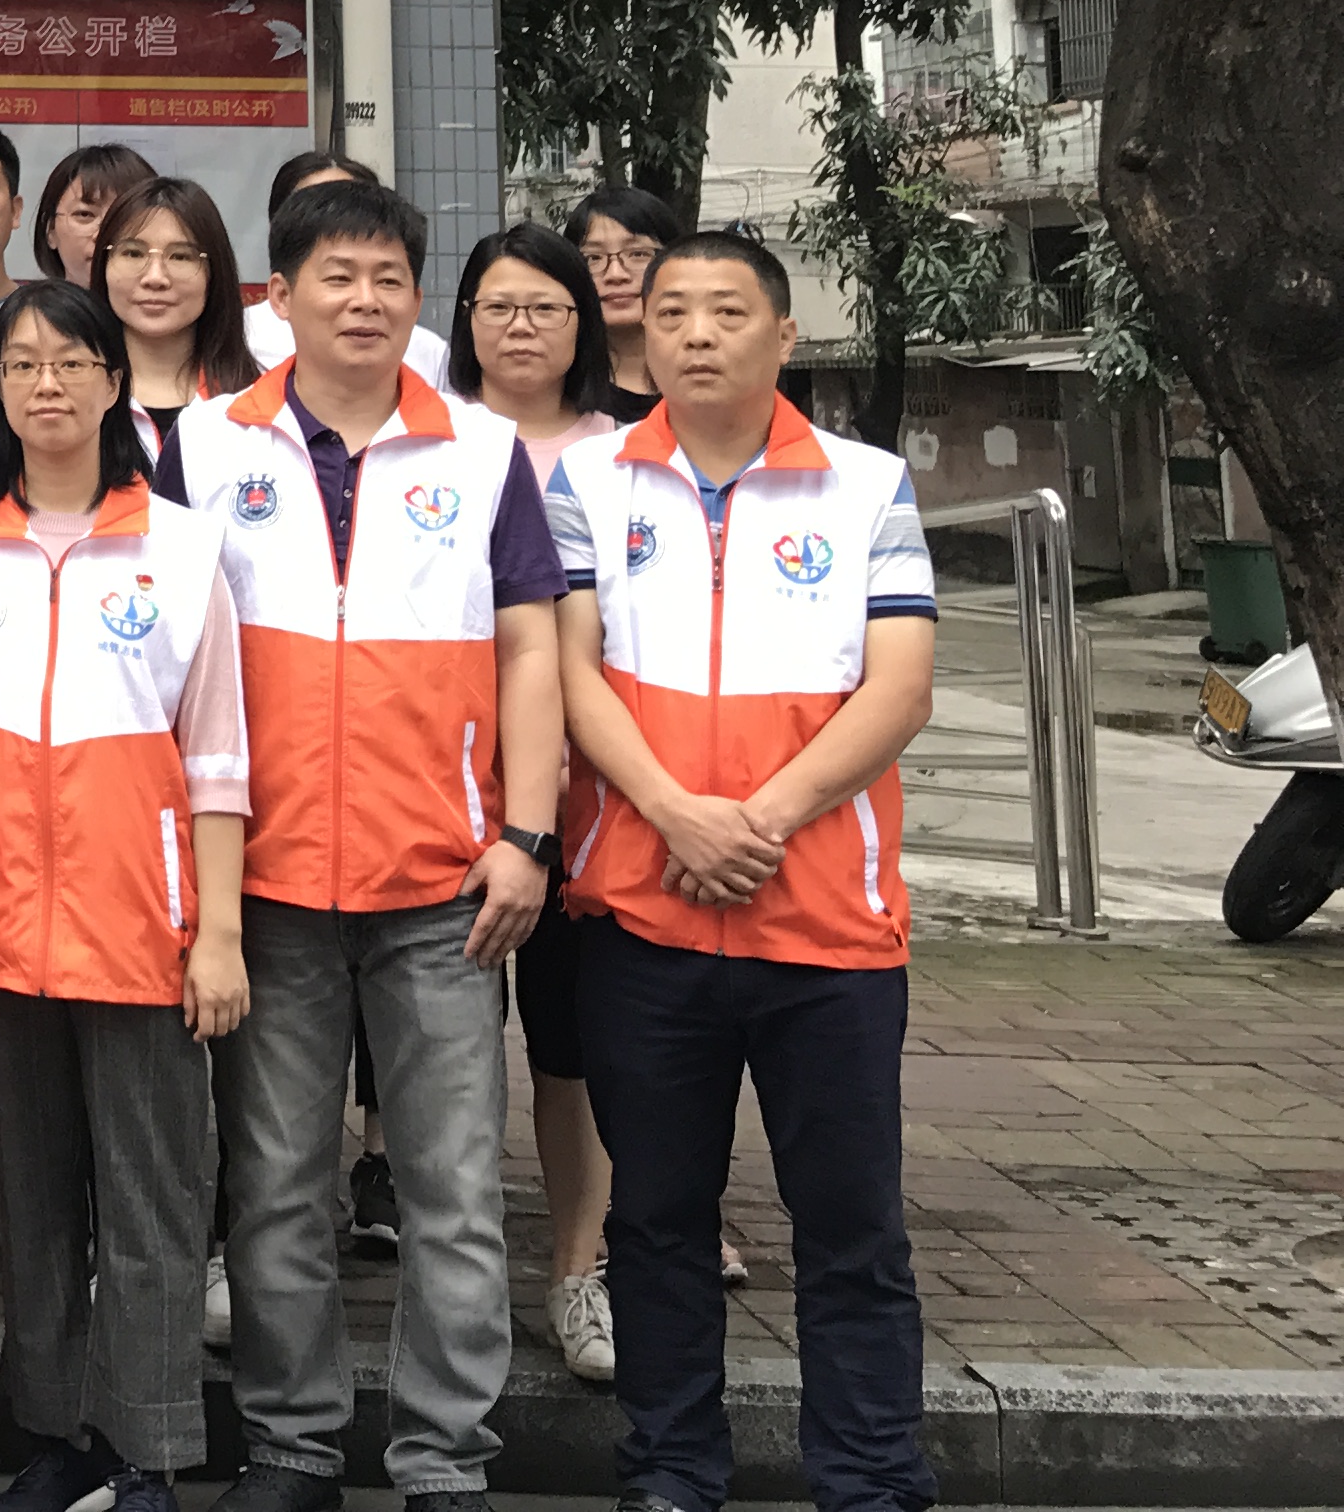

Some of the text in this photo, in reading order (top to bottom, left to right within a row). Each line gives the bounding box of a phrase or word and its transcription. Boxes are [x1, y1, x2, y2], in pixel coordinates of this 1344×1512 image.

[129, 97, 277, 120] 通告栏(及时公开)
